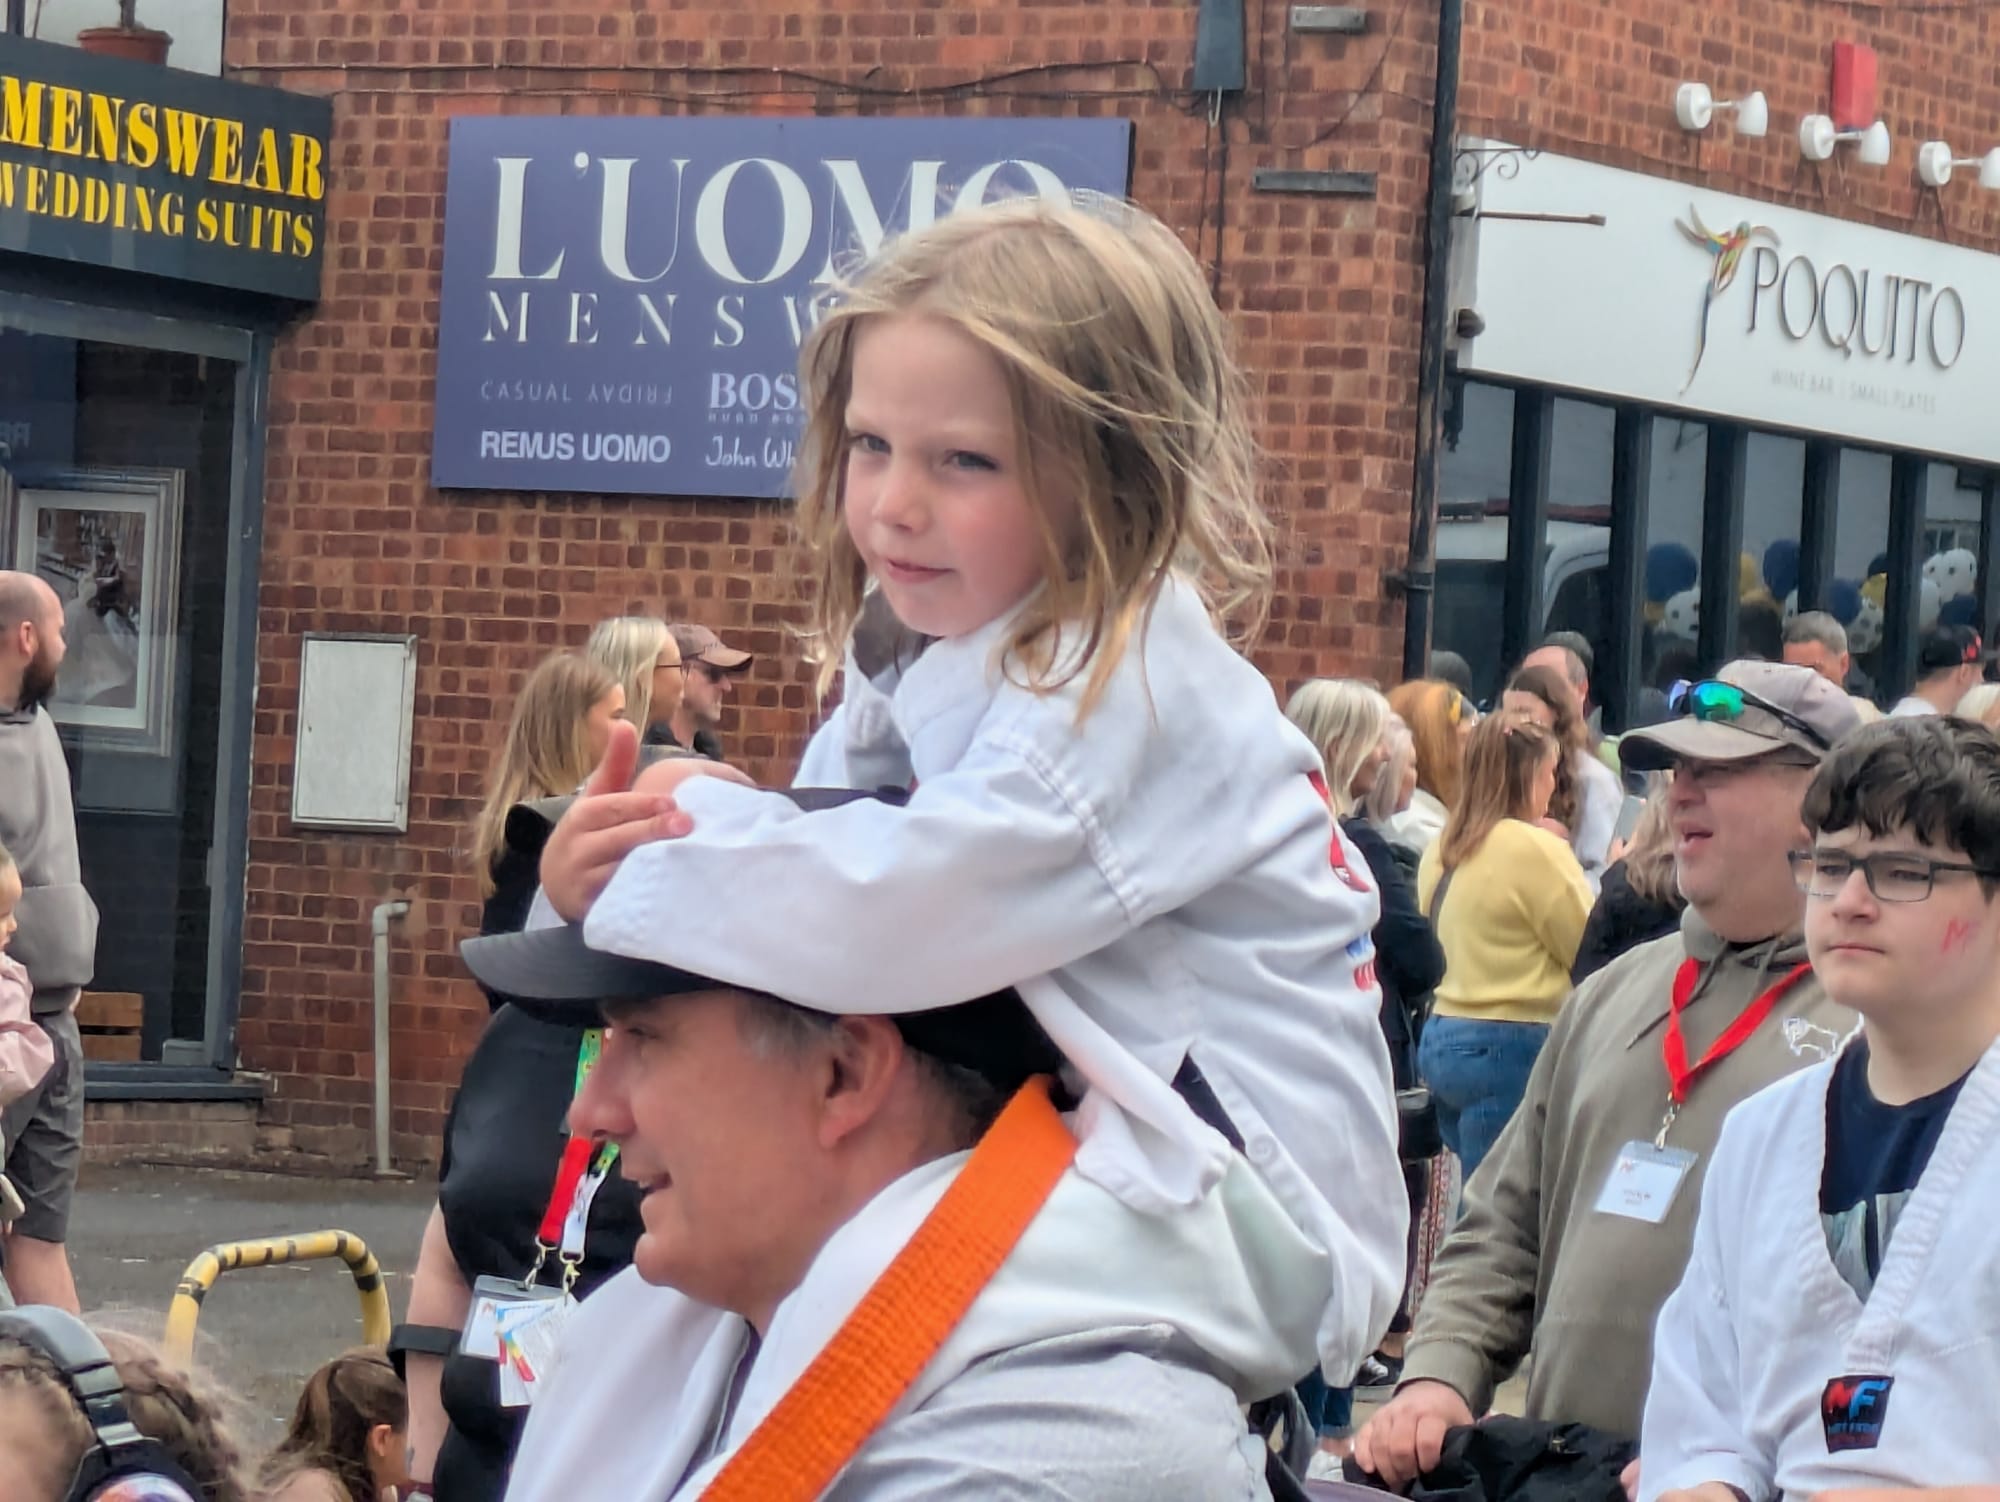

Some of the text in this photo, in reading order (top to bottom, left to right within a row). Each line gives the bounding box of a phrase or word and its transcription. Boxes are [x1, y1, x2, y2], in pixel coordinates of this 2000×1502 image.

[0, 76, 325, 200] MENSWEAR
[196, 198, 313, 257] SUITS
[1747, 246, 1965, 369] POQUITO
[481, 379, 573, 401] CASUAL
[1809, 374, 1834, 395] BAR
[481, 431, 672, 463] REMUS UOMO
[705, 435, 757, 467] John
